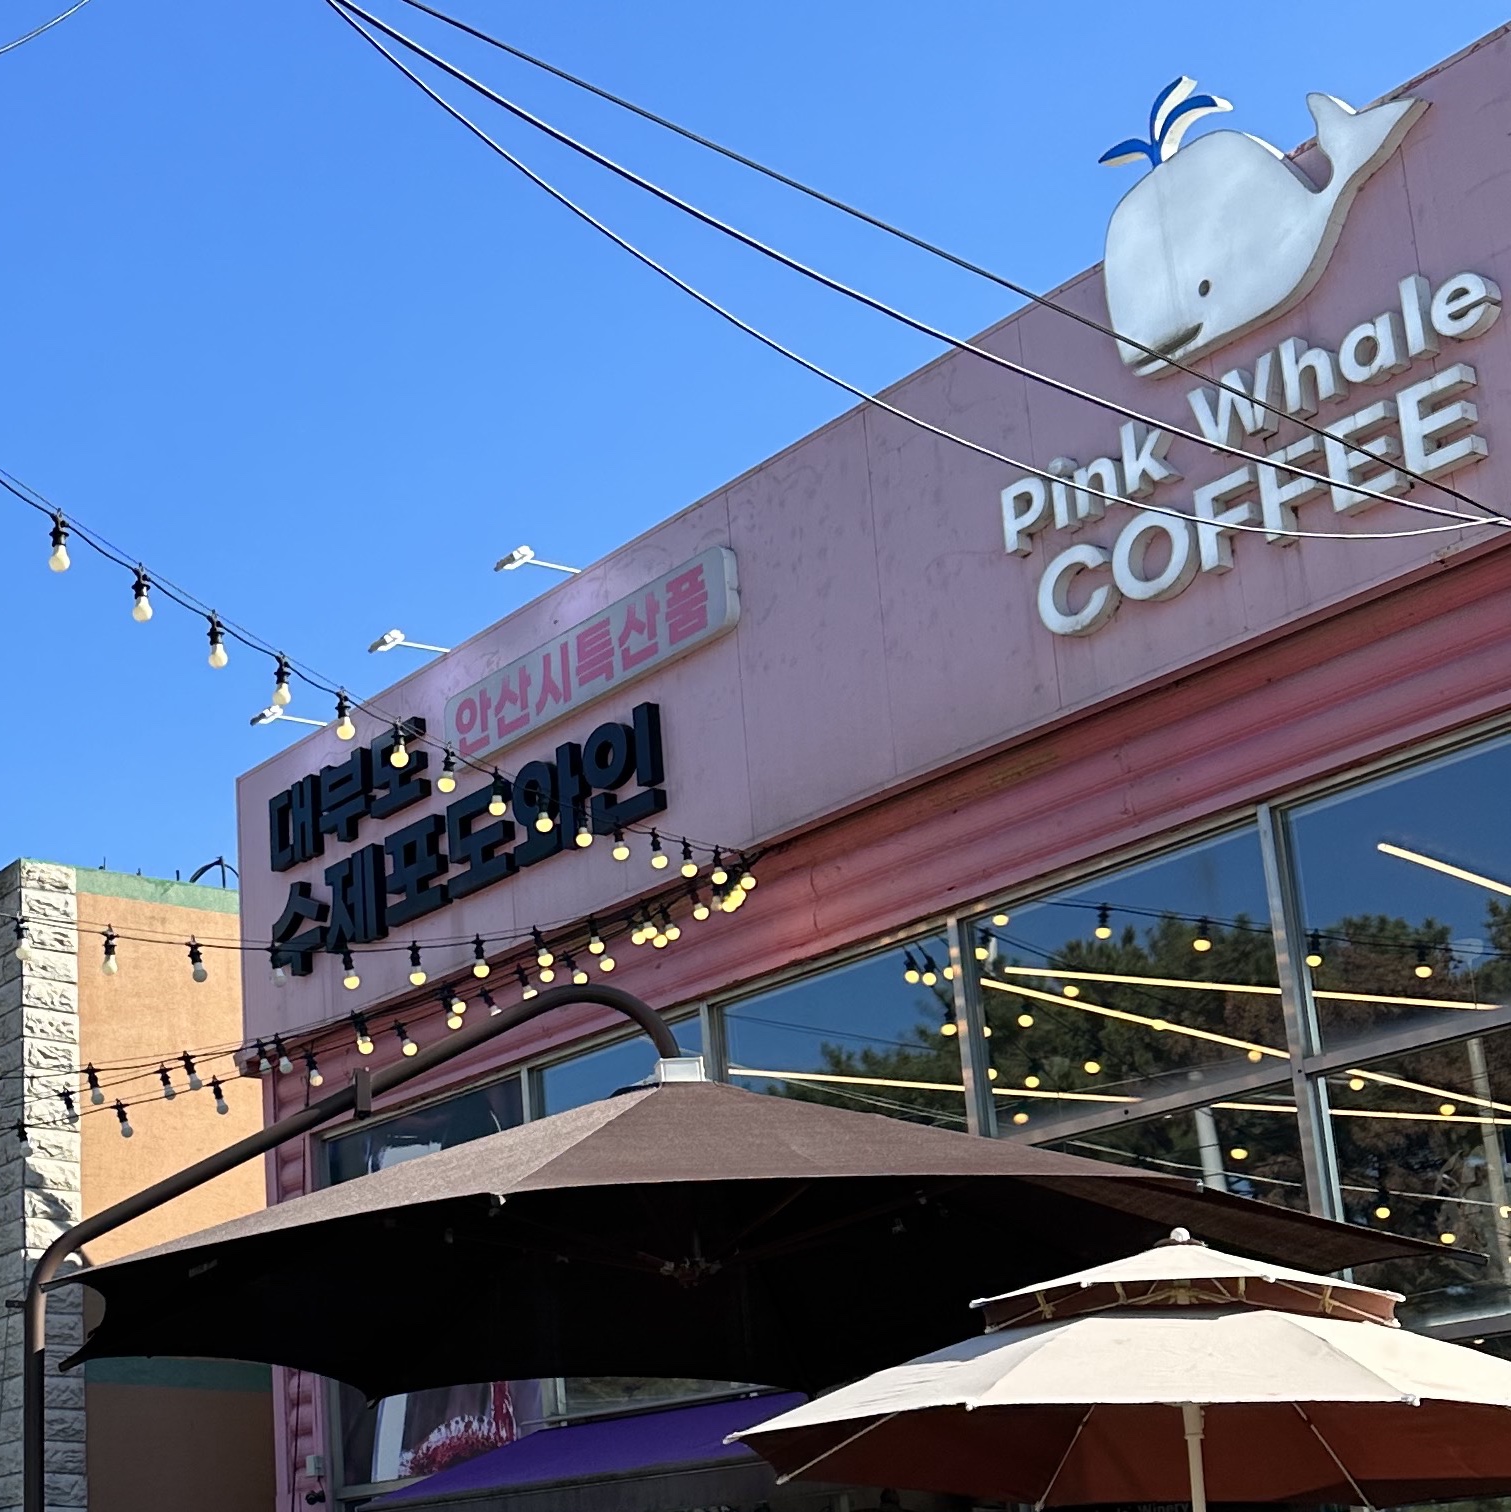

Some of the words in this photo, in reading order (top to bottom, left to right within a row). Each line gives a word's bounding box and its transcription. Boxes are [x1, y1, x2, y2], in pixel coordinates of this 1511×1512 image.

[1000, 419, 1183, 558] Pink
[1187, 271, 1502, 455] Whale
[1037, 362, 1489, 638] COFFEE
[269, 716, 432, 872] 대부도
[454, 562, 710, 756] 안산시특산품
[272, 702, 668, 977] 수제포도와인
